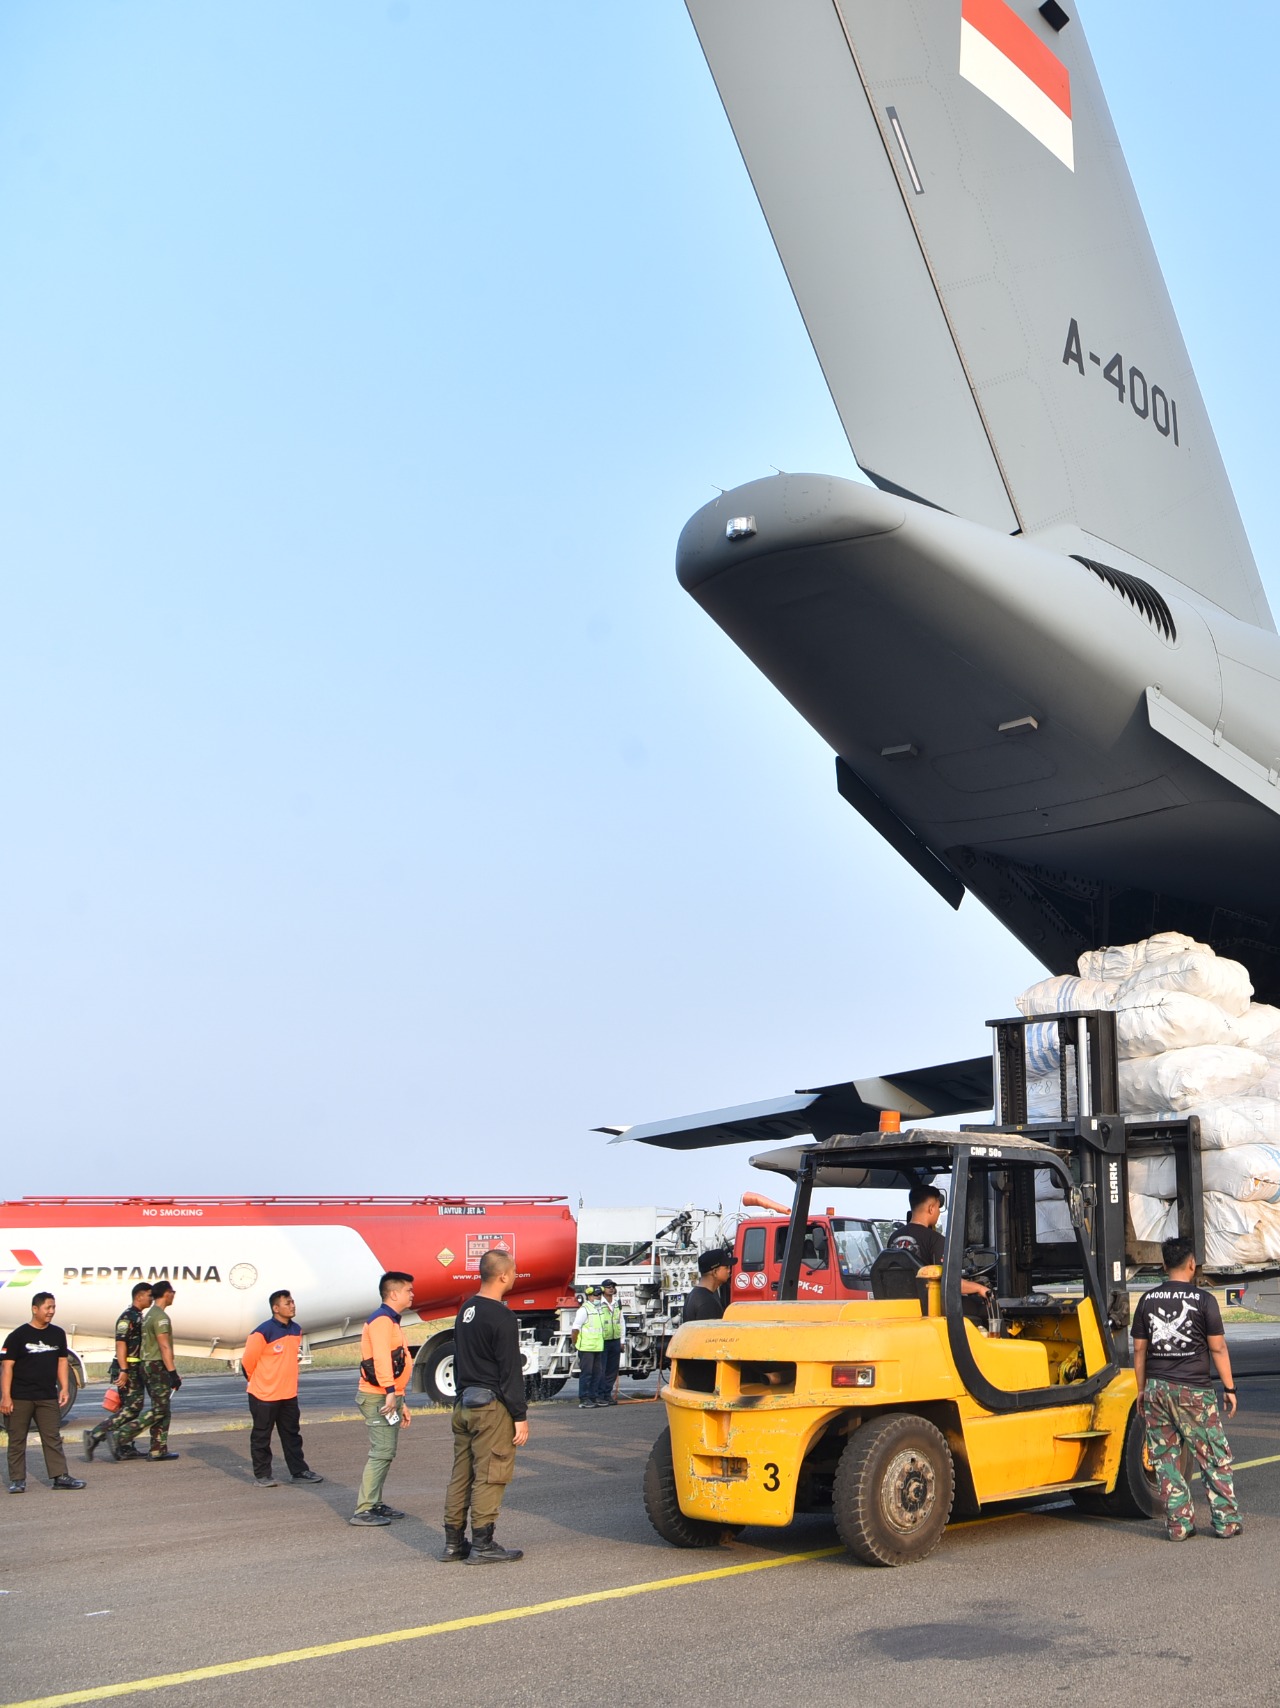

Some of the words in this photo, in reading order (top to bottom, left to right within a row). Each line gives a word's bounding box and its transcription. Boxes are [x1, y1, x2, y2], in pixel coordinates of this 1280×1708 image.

[1062, 317, 1179, 446] A-4001
[970, 1146, 987, 1157] CMP
[1110, 1162, 1119, 1203] CLARK
[143, 1209, 157, 1217] NO
[160, 1209, 203, 1217] SMOKING
[444, 1207, 462, 1215] AVTUR
[63, 1266, 221, 1285] PERTAMINA
[797, 1281, 824, 1294] PK-42
[1145, 1292, 1171, 1300] A400M
[1173, 1292, 1200, 1300] ATLAS
[763, 1462, 781, 1492] 3
